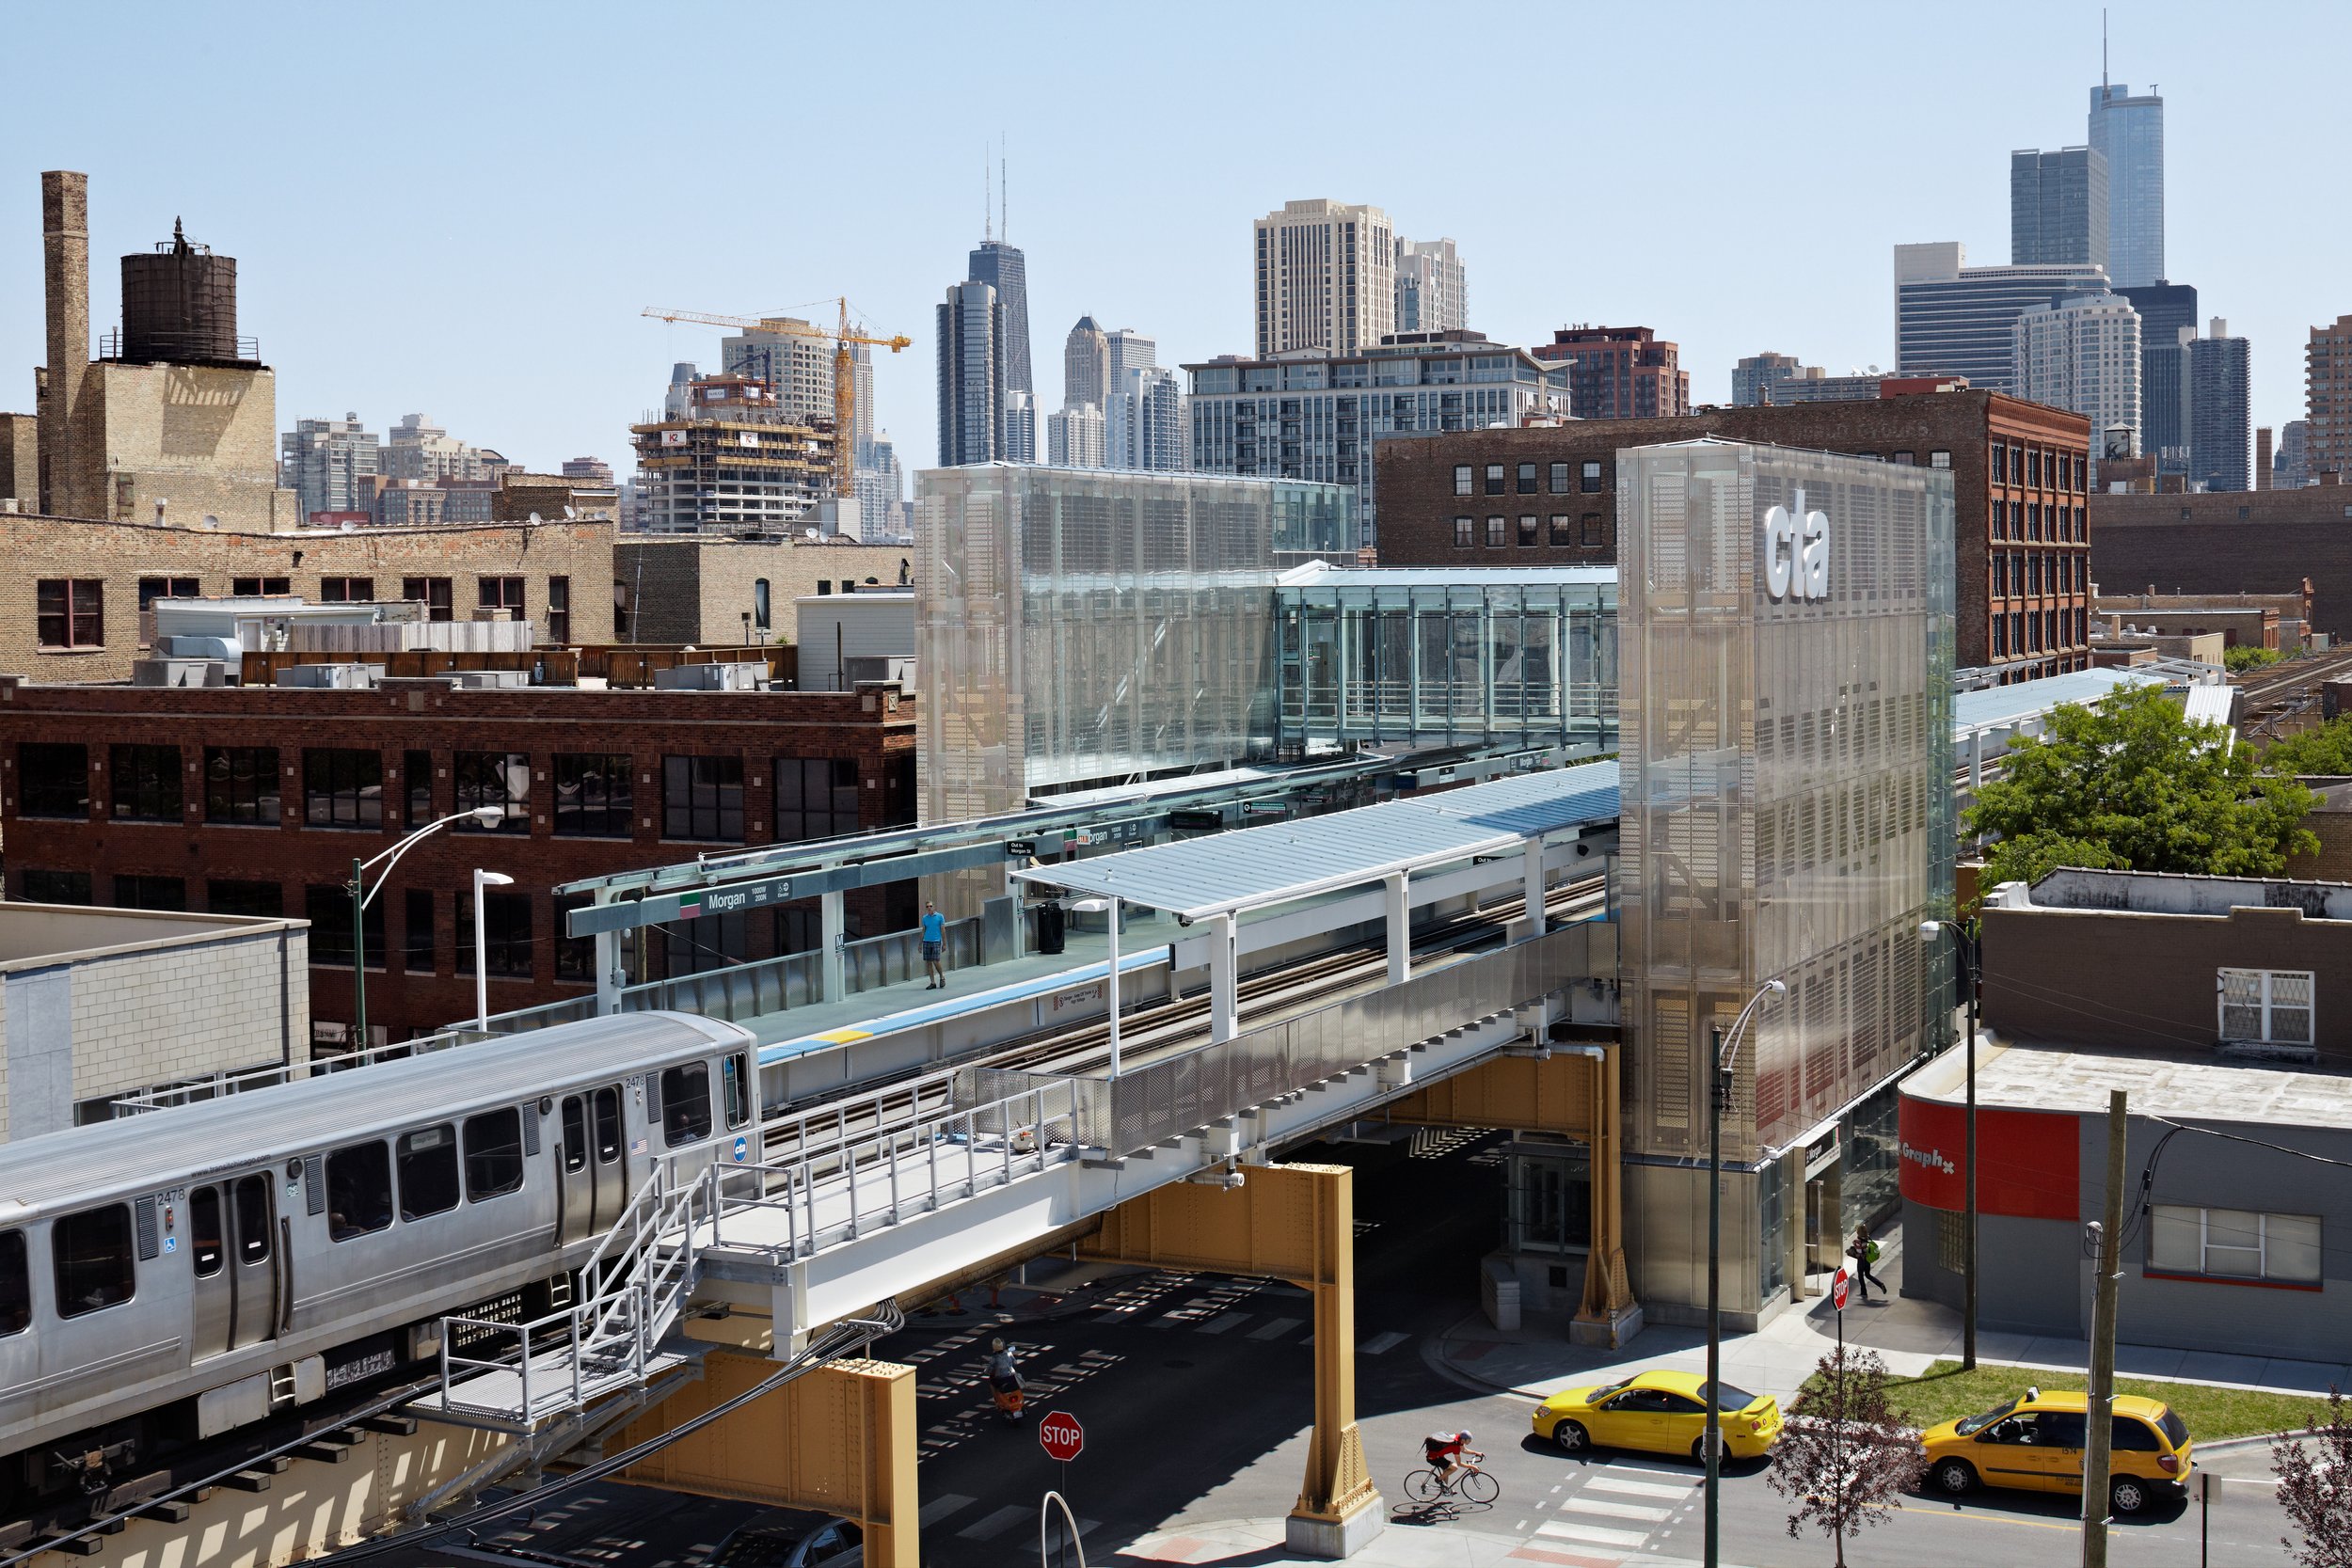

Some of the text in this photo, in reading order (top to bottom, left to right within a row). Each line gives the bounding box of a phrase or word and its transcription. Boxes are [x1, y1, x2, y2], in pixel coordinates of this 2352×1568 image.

[669, 433, 678, 442] K2
[1765, 487, 1829, 599] cta
[1089, 831, 1107, 845] organ
[751, 886, 768, 895] 1000W
[708, 893, 746, 910] Morgan
[755, 894, 768, 903] 200N
[626, 1076, 645, 1089] 2478
[735, 1144, 747, 1154] cta
[157, 1188, 186, 1206] 2478
[1835, 1279, 1848, 1299] STOP
[1043, 1425, 1080, 1447] STOP
